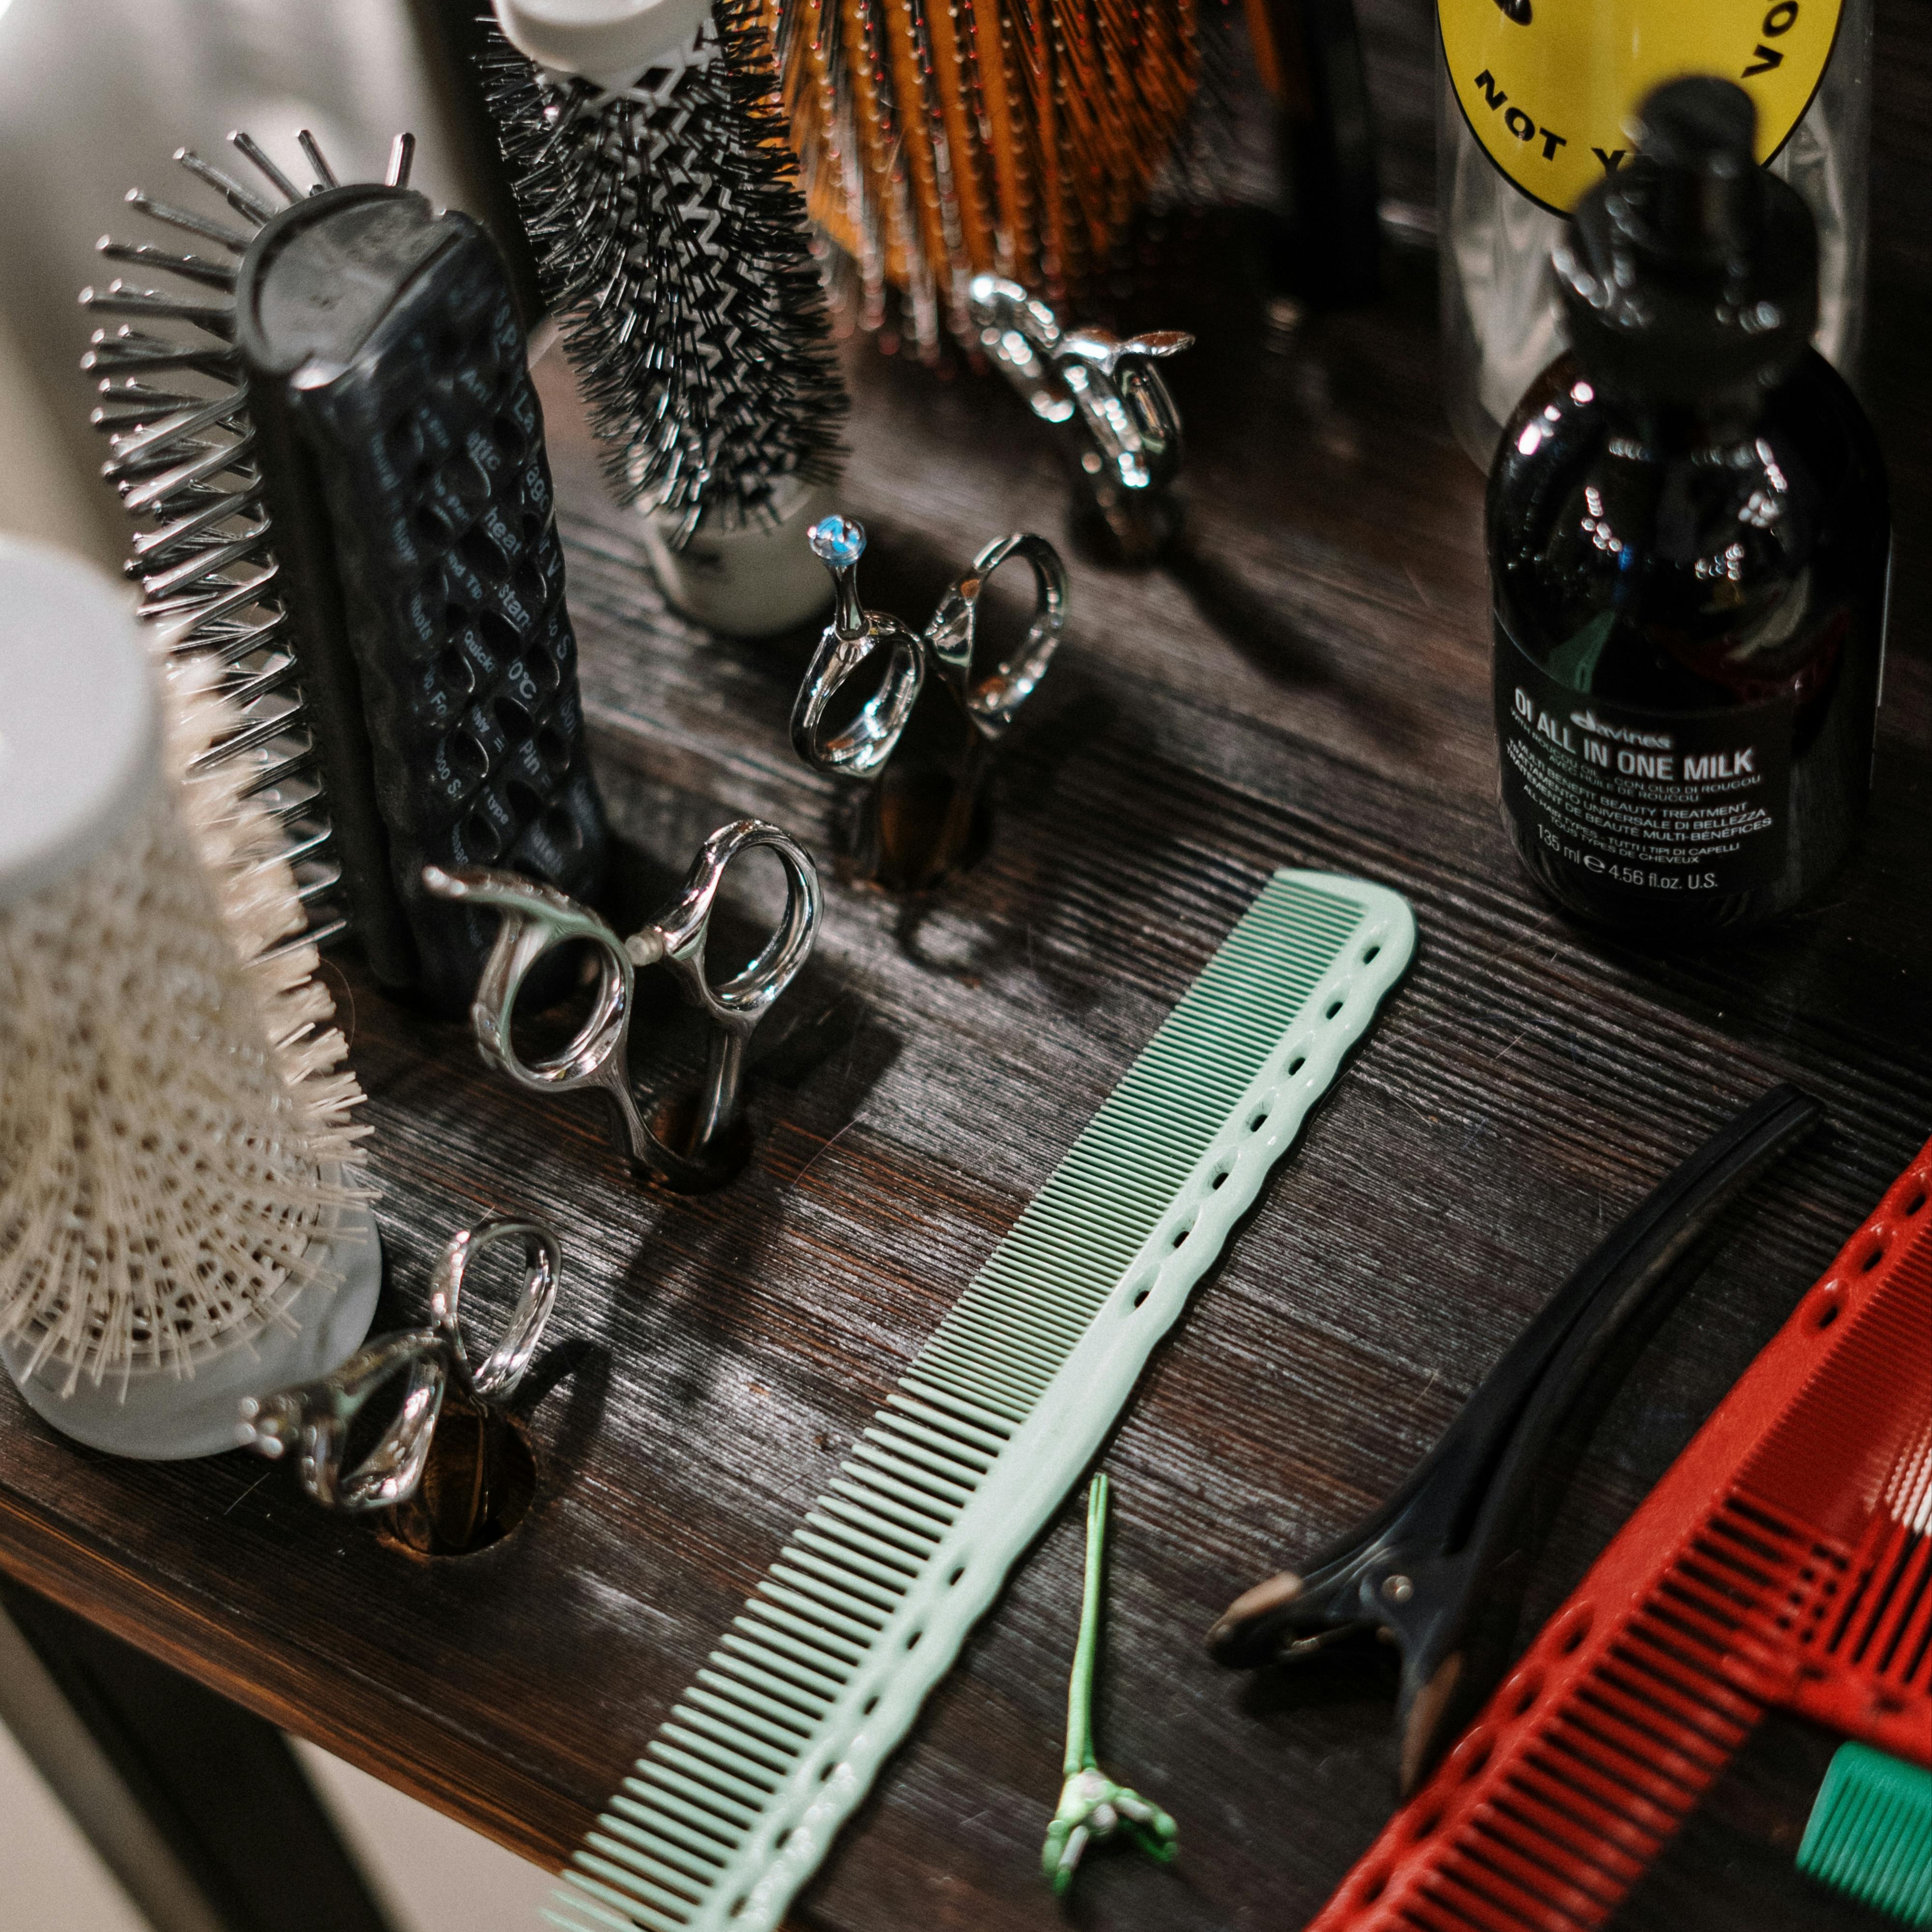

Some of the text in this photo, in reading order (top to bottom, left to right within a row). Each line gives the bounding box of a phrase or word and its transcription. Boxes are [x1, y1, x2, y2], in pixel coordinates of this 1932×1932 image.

[1473, 69, 1567, 162] NOT
[1537, 711, 1577, 754] ALL
[1583, 738, 1608, 767] IN
[1617, 750, 1675, 781] ONE
[1683, 747, 1754, 781] MILK
[1614, 777, 1644, 790] CON
[1648, 784, 1681, 795] OLIO
[1684, 786, 1698, 795] DI
[1701, 774, 1761, 793] ROUCOU
[1618, 786, 1634, 796] DE
[1639, 789, 1700, 802] ROUCOU
[1565, 802, 1583, 819] DE
[1585, 812, 1640, 837] BEAUTÉ
[1583, 800, 1671, 830] UNIVERSALE
[1675, 822, 1690, 830] DI
[1693, 808, 1766, 830] BELLEZZA
[1600, 796, 1657, 817] BEAUTY
[1662, 801, 1748, 819] TREATMENT
[1537, 823, 1560, 852] 135
[1563, 846, 1580, 865] ml
[1608, 864, 1643, 886] 4.56
[1648, 872, 1683, 889] fl.oz.
[1688, 873, 1719, 890] U.S.
[1608, 837, 1640, 852] TUTTI
[1648, 846, 1670, 854] TIPI
[1673, 848, 1686, 856] DI
[1688, 841, 1740, 856] CAPELLI
[1619, 849, 1636, 859] DE
[1638, 852, 1700, 864] CHEVEUX
